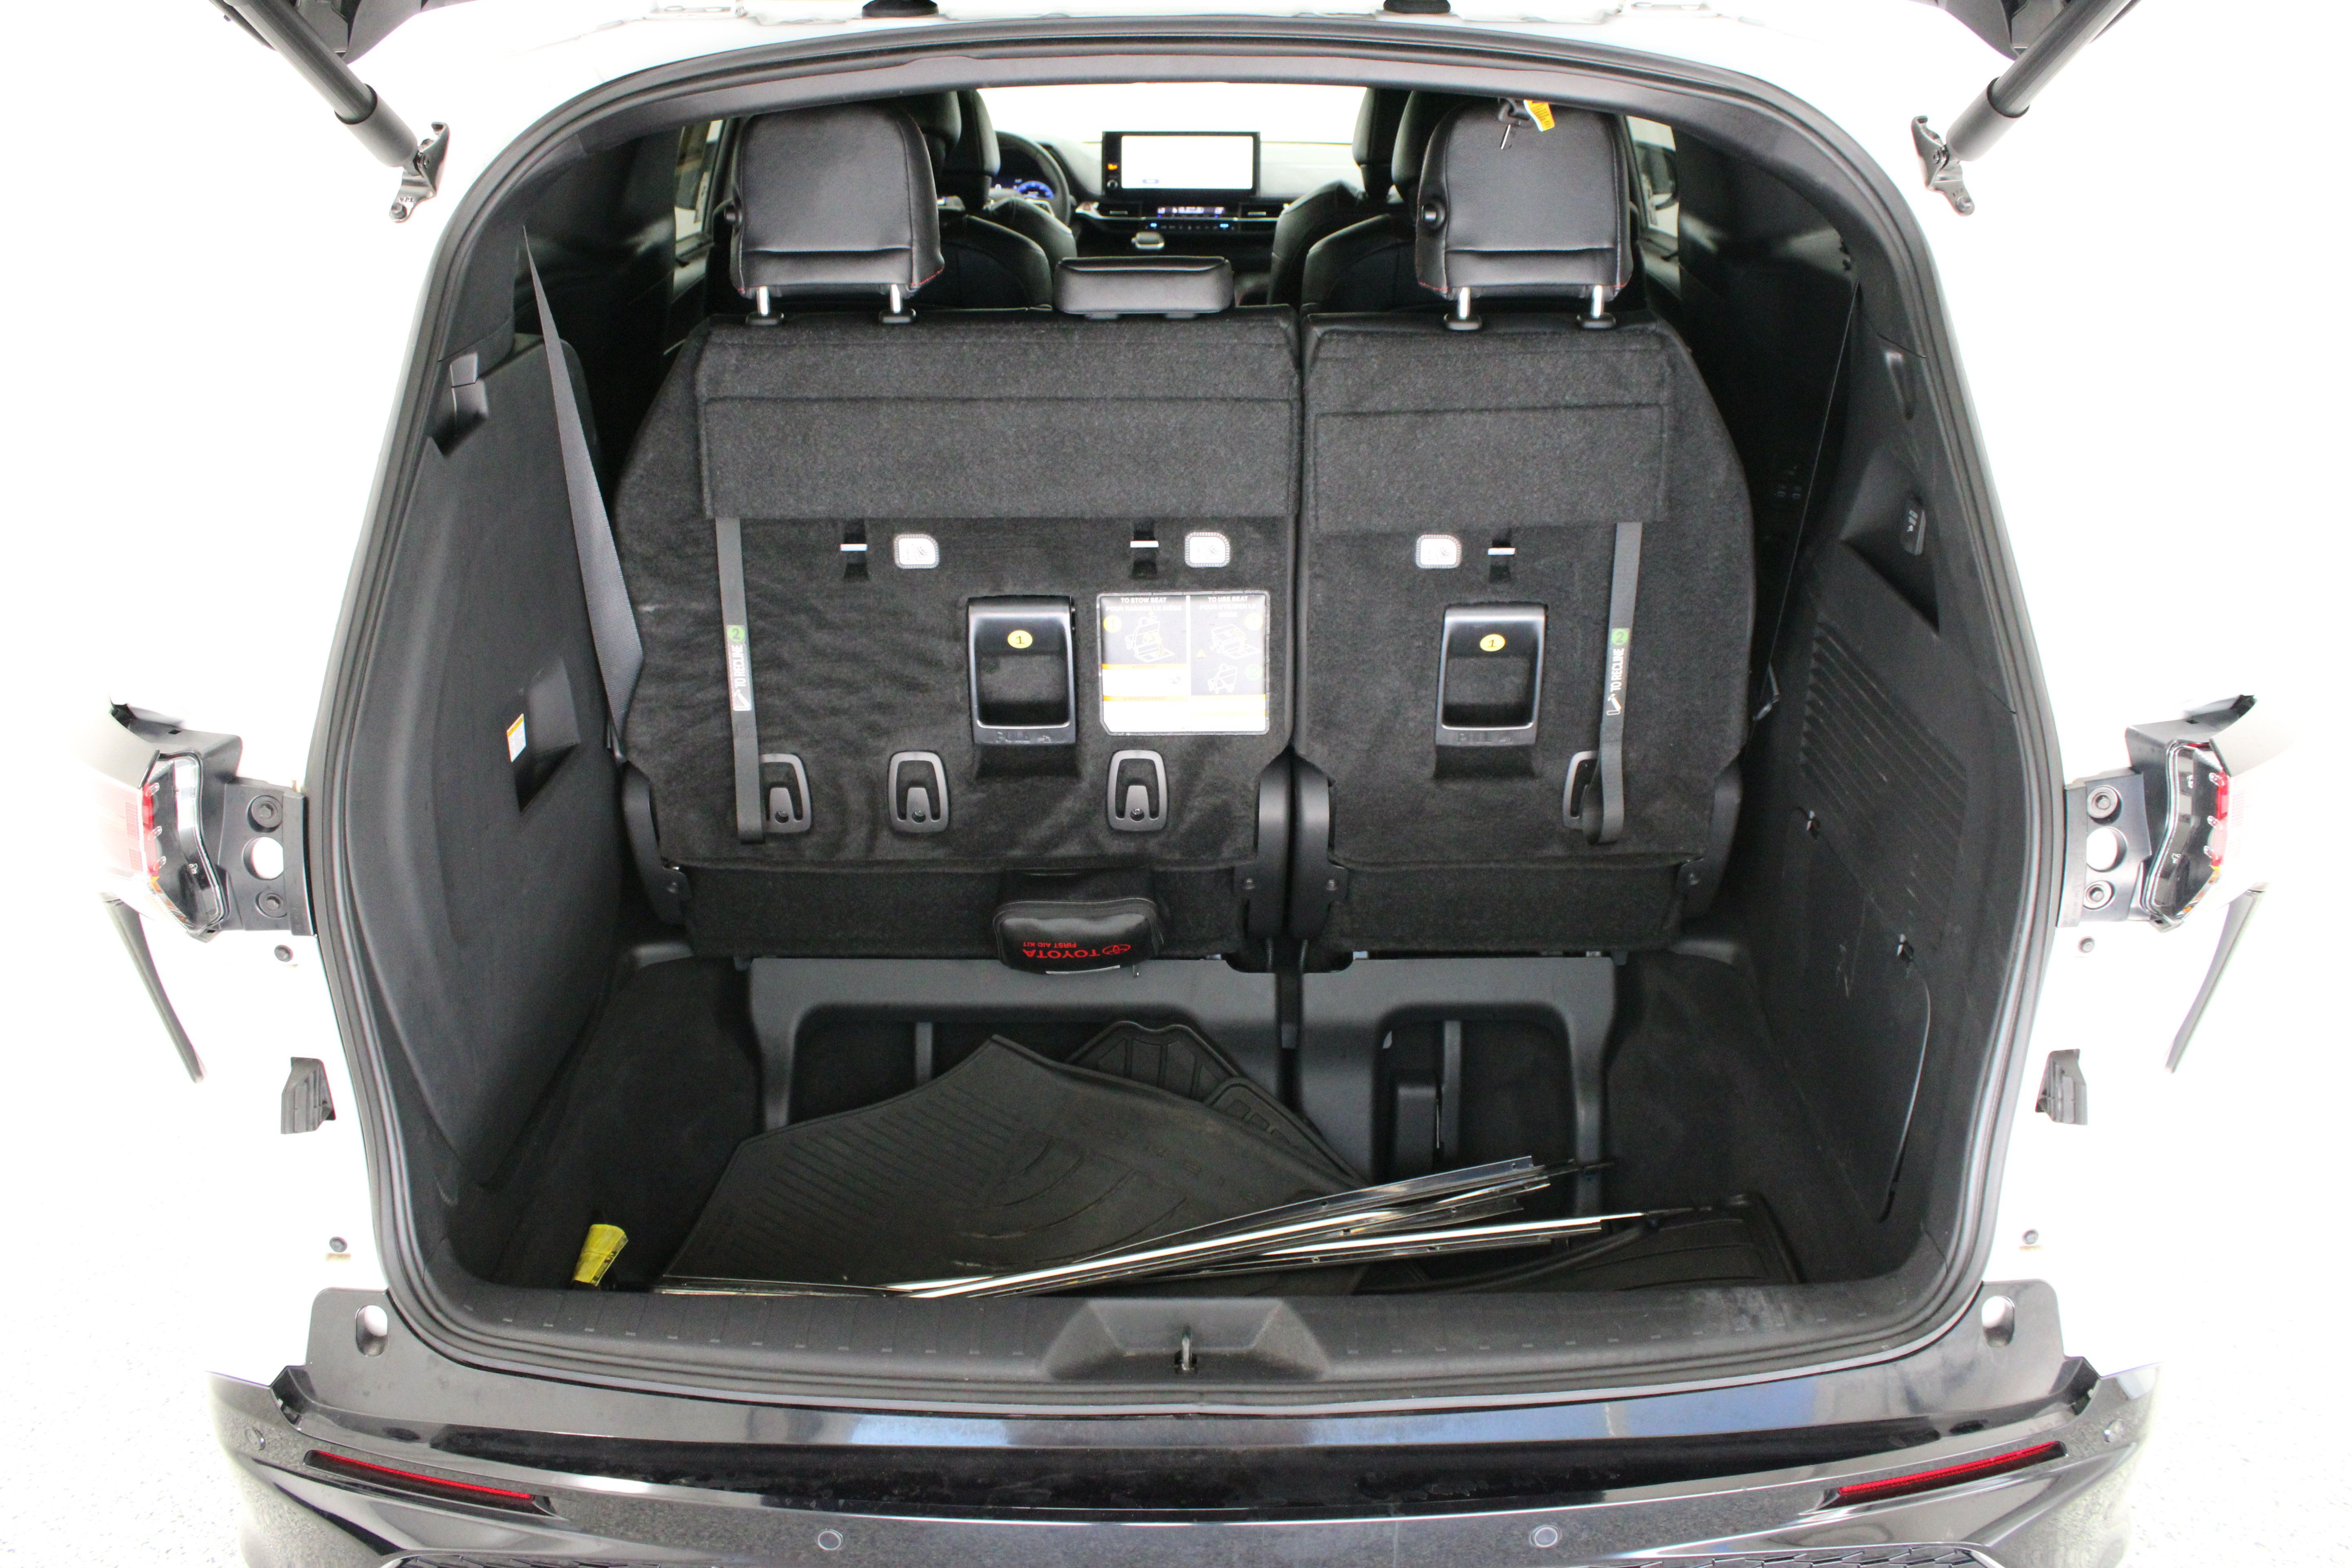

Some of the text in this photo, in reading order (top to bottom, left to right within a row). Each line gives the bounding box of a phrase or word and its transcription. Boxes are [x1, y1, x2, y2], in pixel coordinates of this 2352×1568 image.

[732, 628, 740, 640] 2
[1016, 635, 1025, 644] 1
[1616, 631, 1624, 643] 2
[1487, 639, 1496, 648] 1
[731, 644, 746, 688] TO RECLINE
[1610, 648, 1624, 692] TO RECLINE
[1022, 949, 1100, 958] TOYOTA
